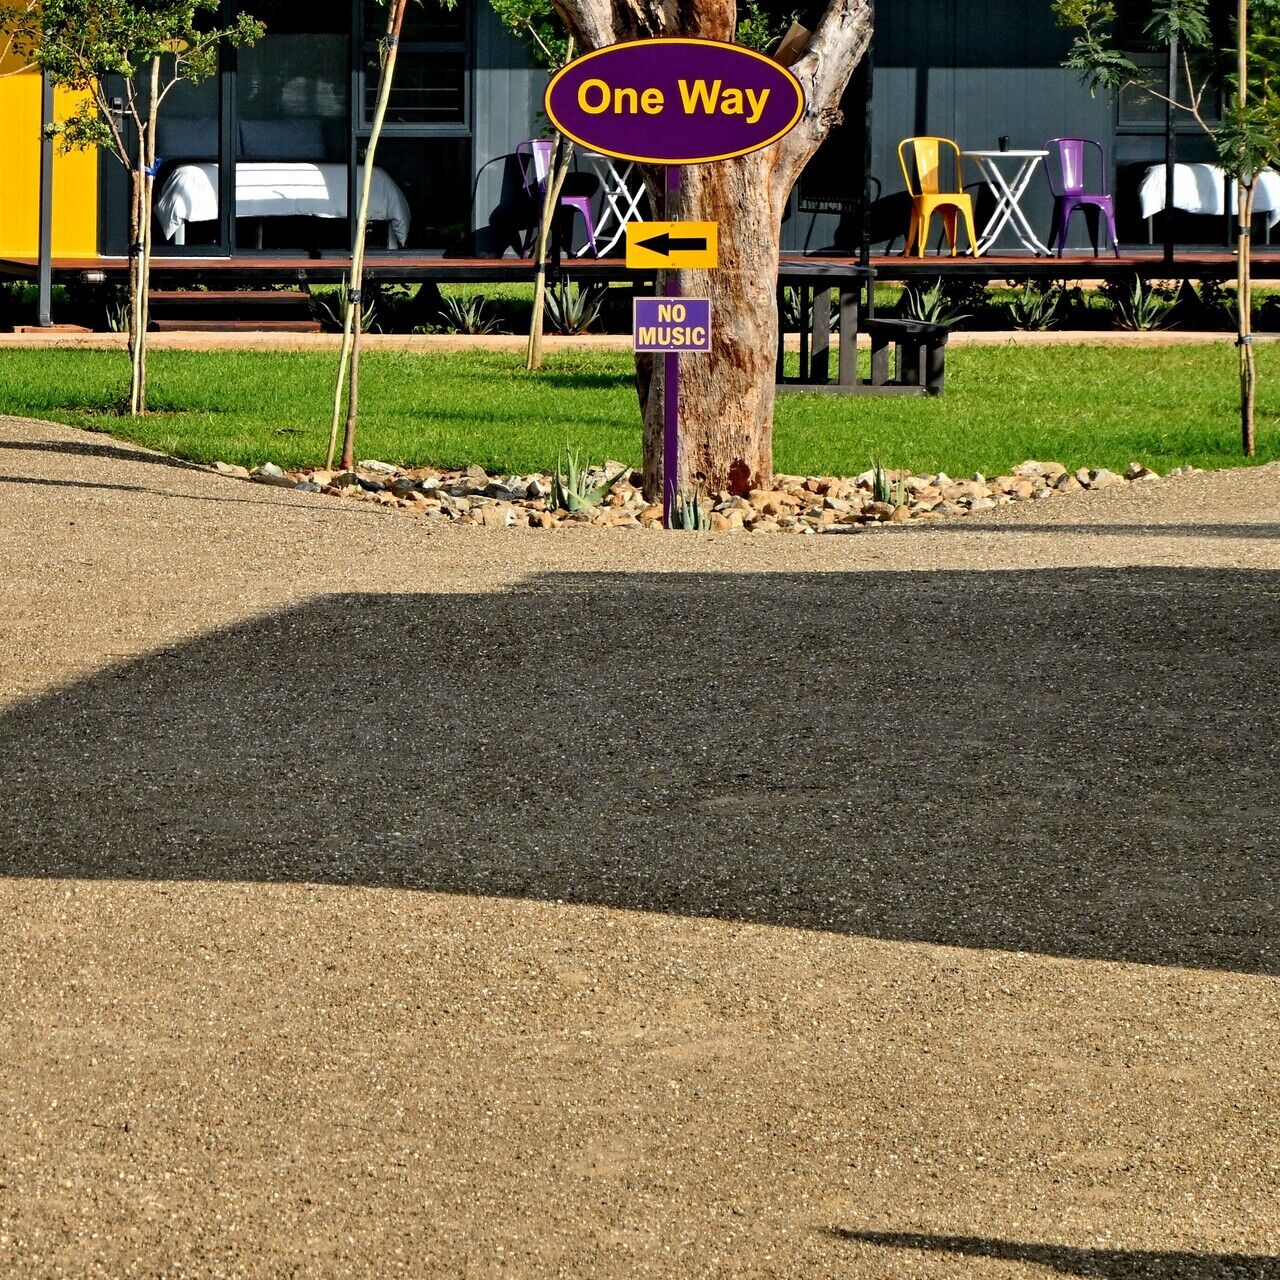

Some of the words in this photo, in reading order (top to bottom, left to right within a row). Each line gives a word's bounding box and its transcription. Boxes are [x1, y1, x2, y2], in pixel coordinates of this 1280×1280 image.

[577, 78, 665, 115] One
[677, 79, 771, 124] Way
[658, 304, 686, 323] NO
[638, 326, 706, 346] MUSIC
